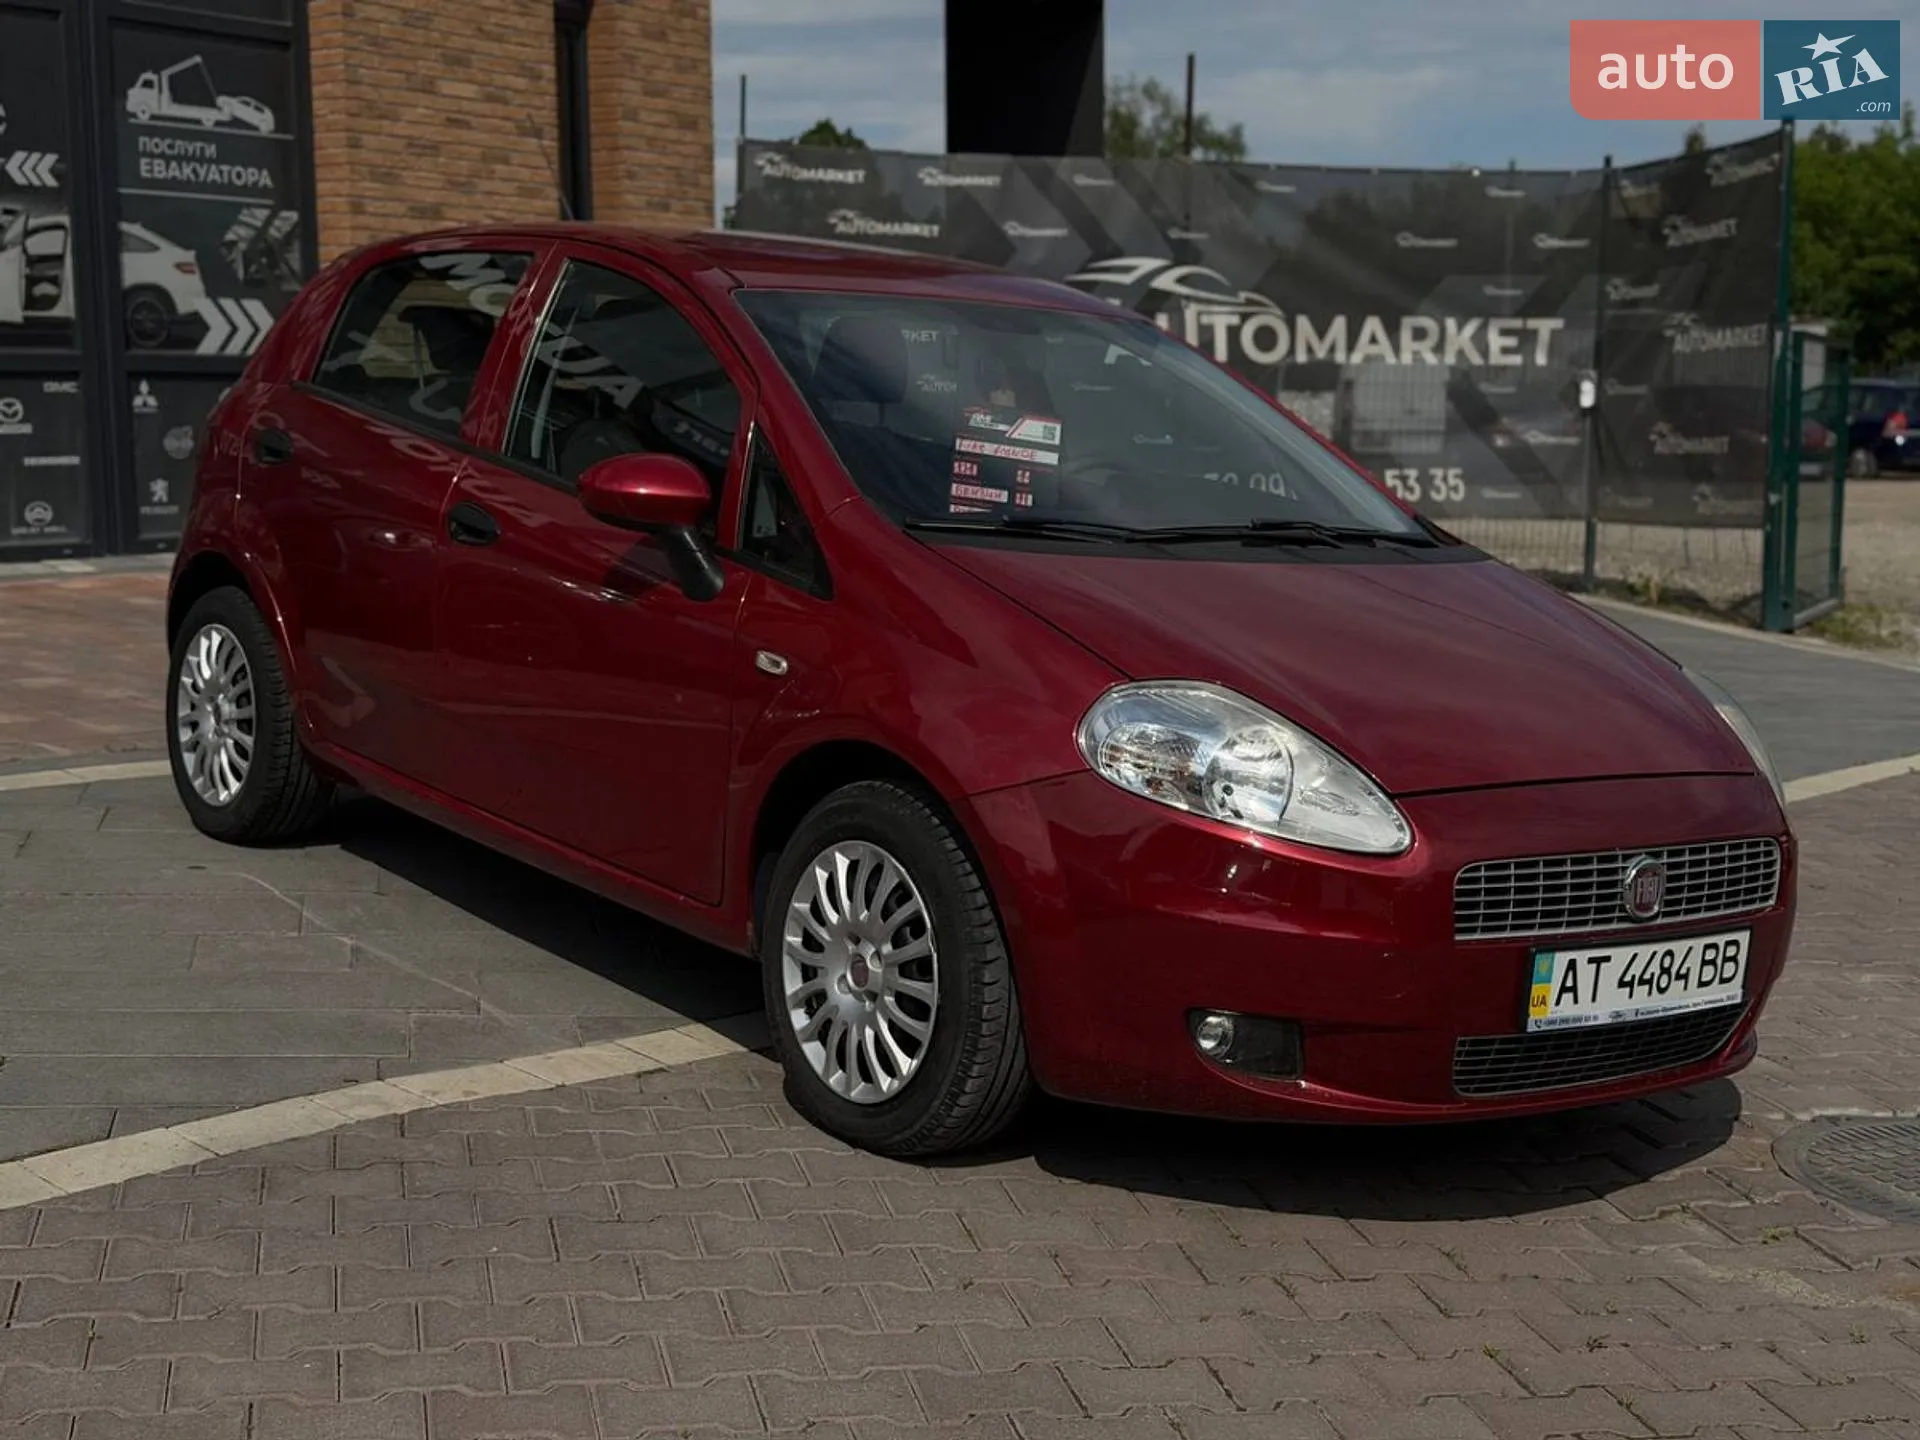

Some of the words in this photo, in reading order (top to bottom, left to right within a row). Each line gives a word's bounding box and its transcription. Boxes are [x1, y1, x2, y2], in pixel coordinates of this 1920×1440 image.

[138, 136, 217, 160] ПОСЛУГИ
[140, 159, 275, 189] ЕВАКУАТОРА
[762, 163, 867, 184] AUTOMARKET
[835, 219, 941, 238] AUTOMARKET
[1384, 468, 1421, 503] 53
[1428, 467, 1465, 502] 35
[1554, 955, 1612, 1007] AT
[1532, 994, 1548, 1008] UA
